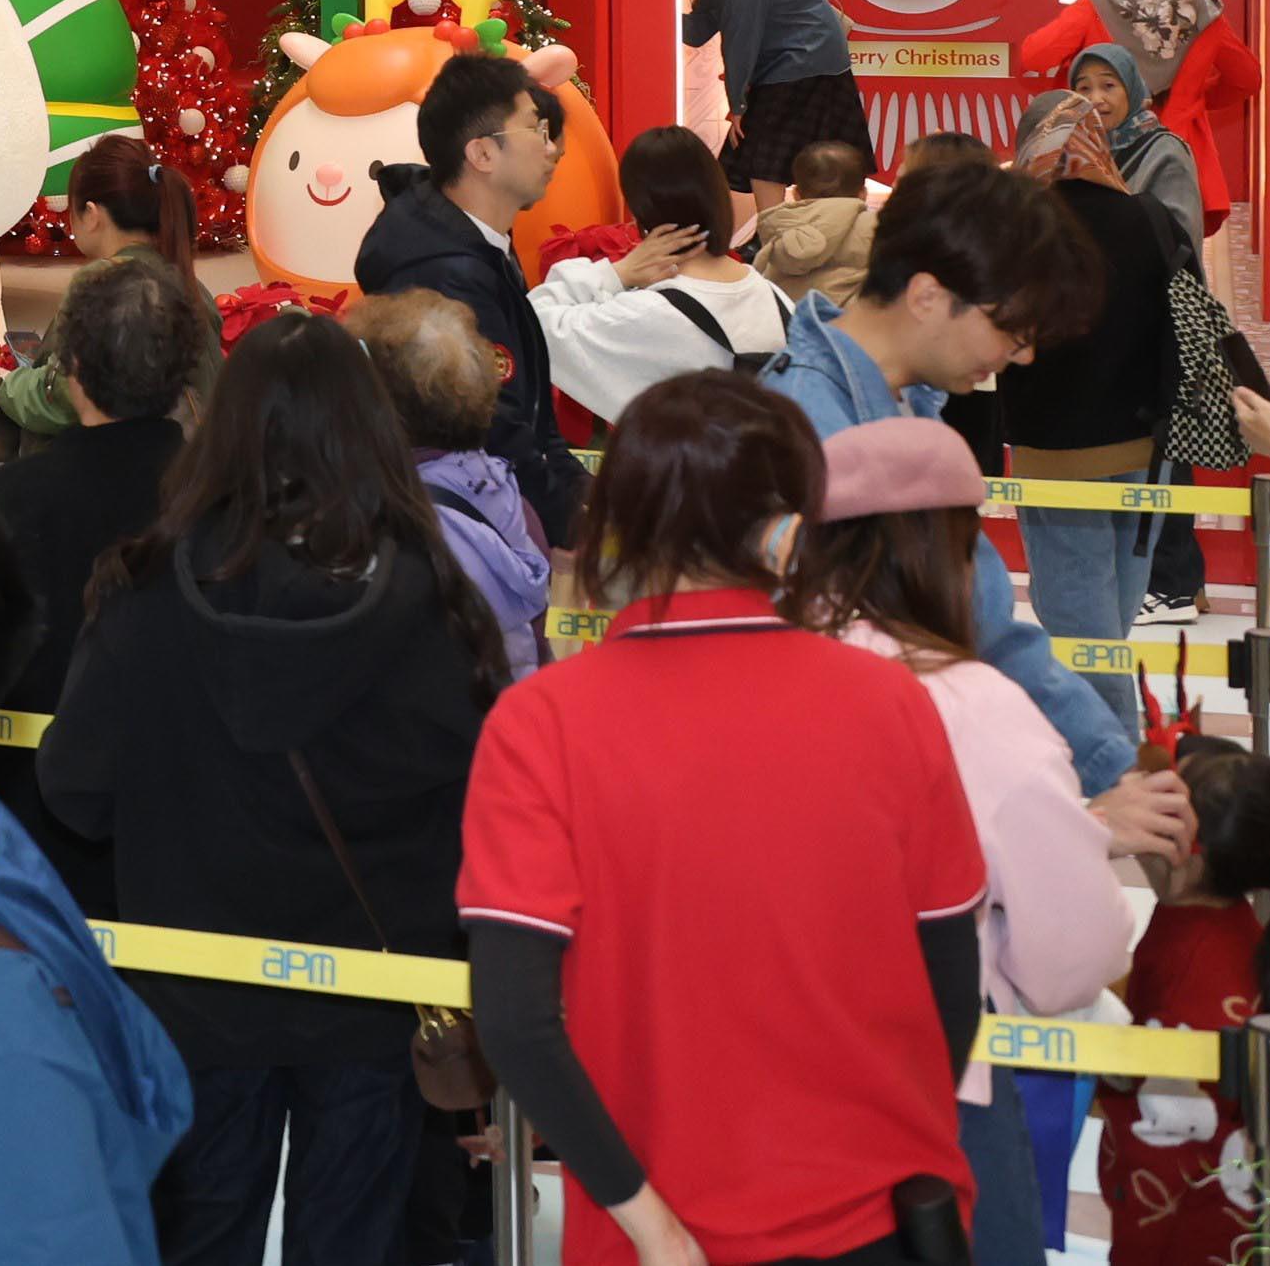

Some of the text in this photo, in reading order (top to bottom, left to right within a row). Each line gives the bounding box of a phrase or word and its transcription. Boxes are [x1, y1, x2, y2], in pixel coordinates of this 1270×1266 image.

[847, 48, 1001, 69] erry Christmas
[987, 481, 1023, 502] pm
[1121, 487, 1172, 509] apm
[1072, 643, 1133, 669] apm
[261, 946, 336, 987] apm
[987, 1021, 1076, 1063] apm
